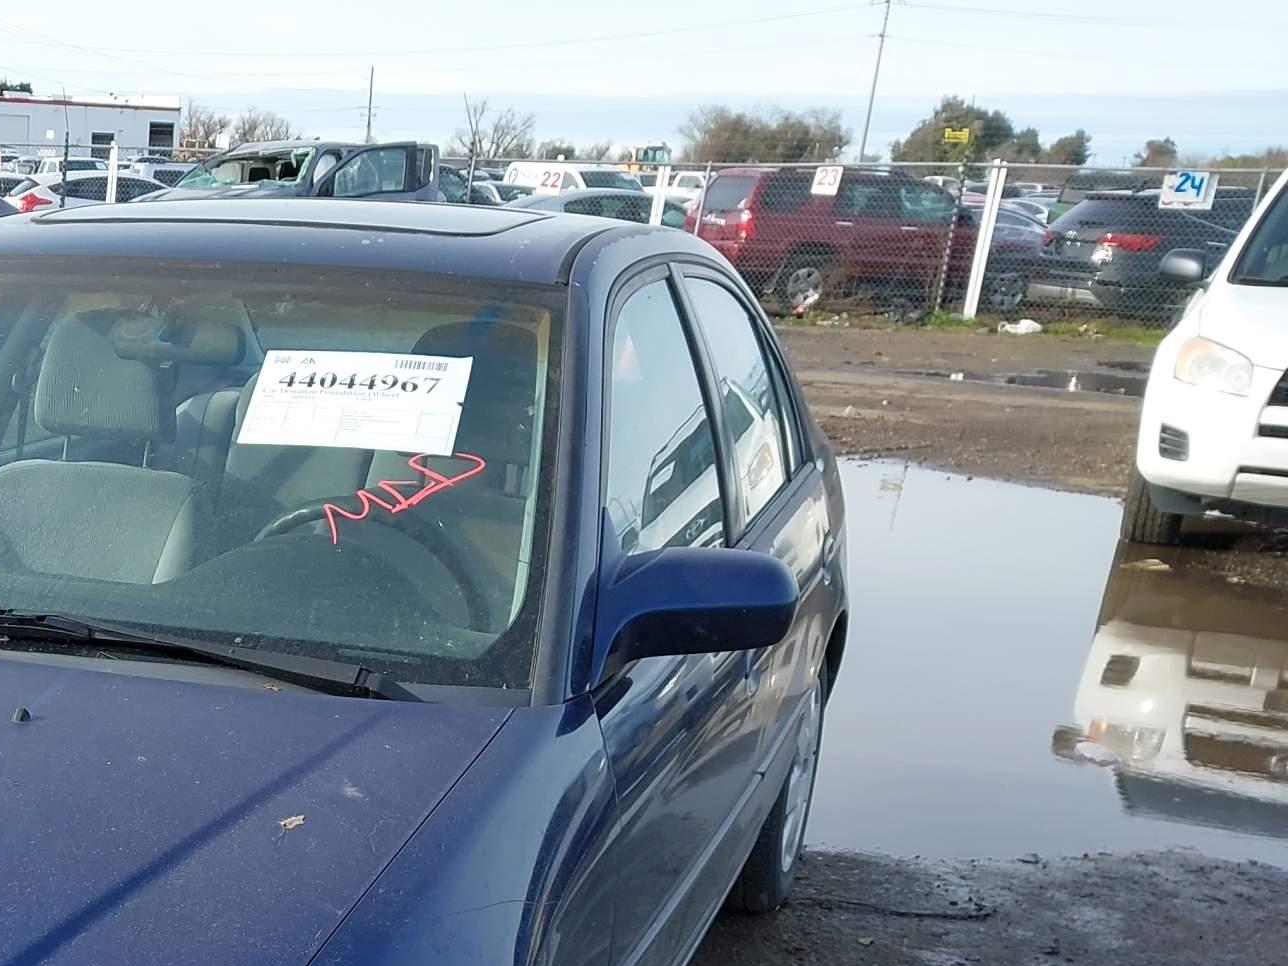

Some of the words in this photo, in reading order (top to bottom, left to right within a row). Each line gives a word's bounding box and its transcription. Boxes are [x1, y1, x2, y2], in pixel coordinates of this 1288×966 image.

[540, 170, 561, 188] 22
[816, 168, 840, 186] 23
[1174, 172, 1205, 198] 24
[278, 371, 443, 394] 44044967
